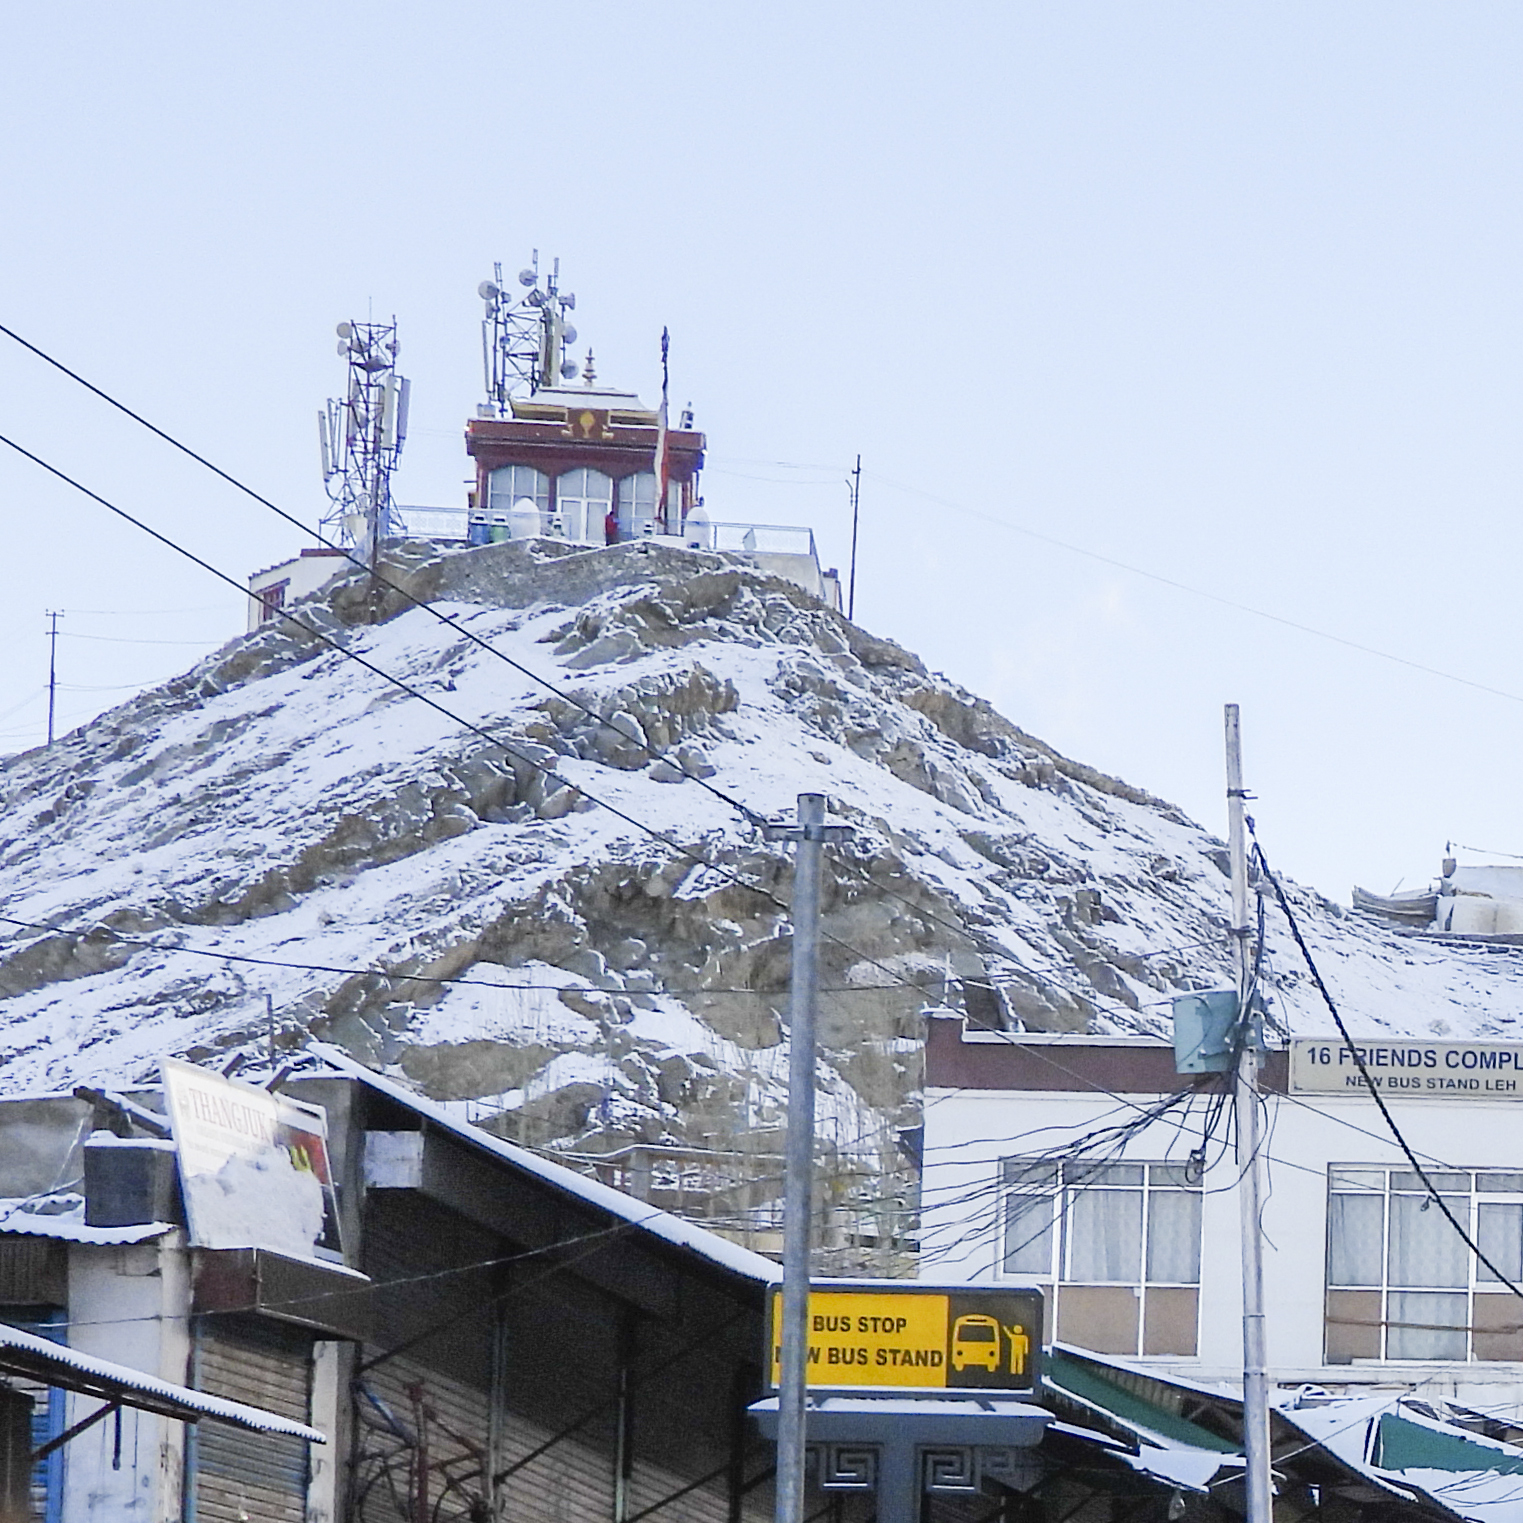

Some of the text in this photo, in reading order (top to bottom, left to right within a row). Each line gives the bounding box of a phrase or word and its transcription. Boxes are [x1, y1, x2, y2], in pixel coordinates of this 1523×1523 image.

[1307, 1046, 1331, 1066] 16
[1338, 1047, 1437, 1069] FRIENDS
[1345, 1075, 1516, 1091] NEW BUS STAND LEH
[813, 1315, 907, 1334] BUS STOP
[827, 1347, 868, 1366] BUS
[875, 1348, 943, 1368] STAND
